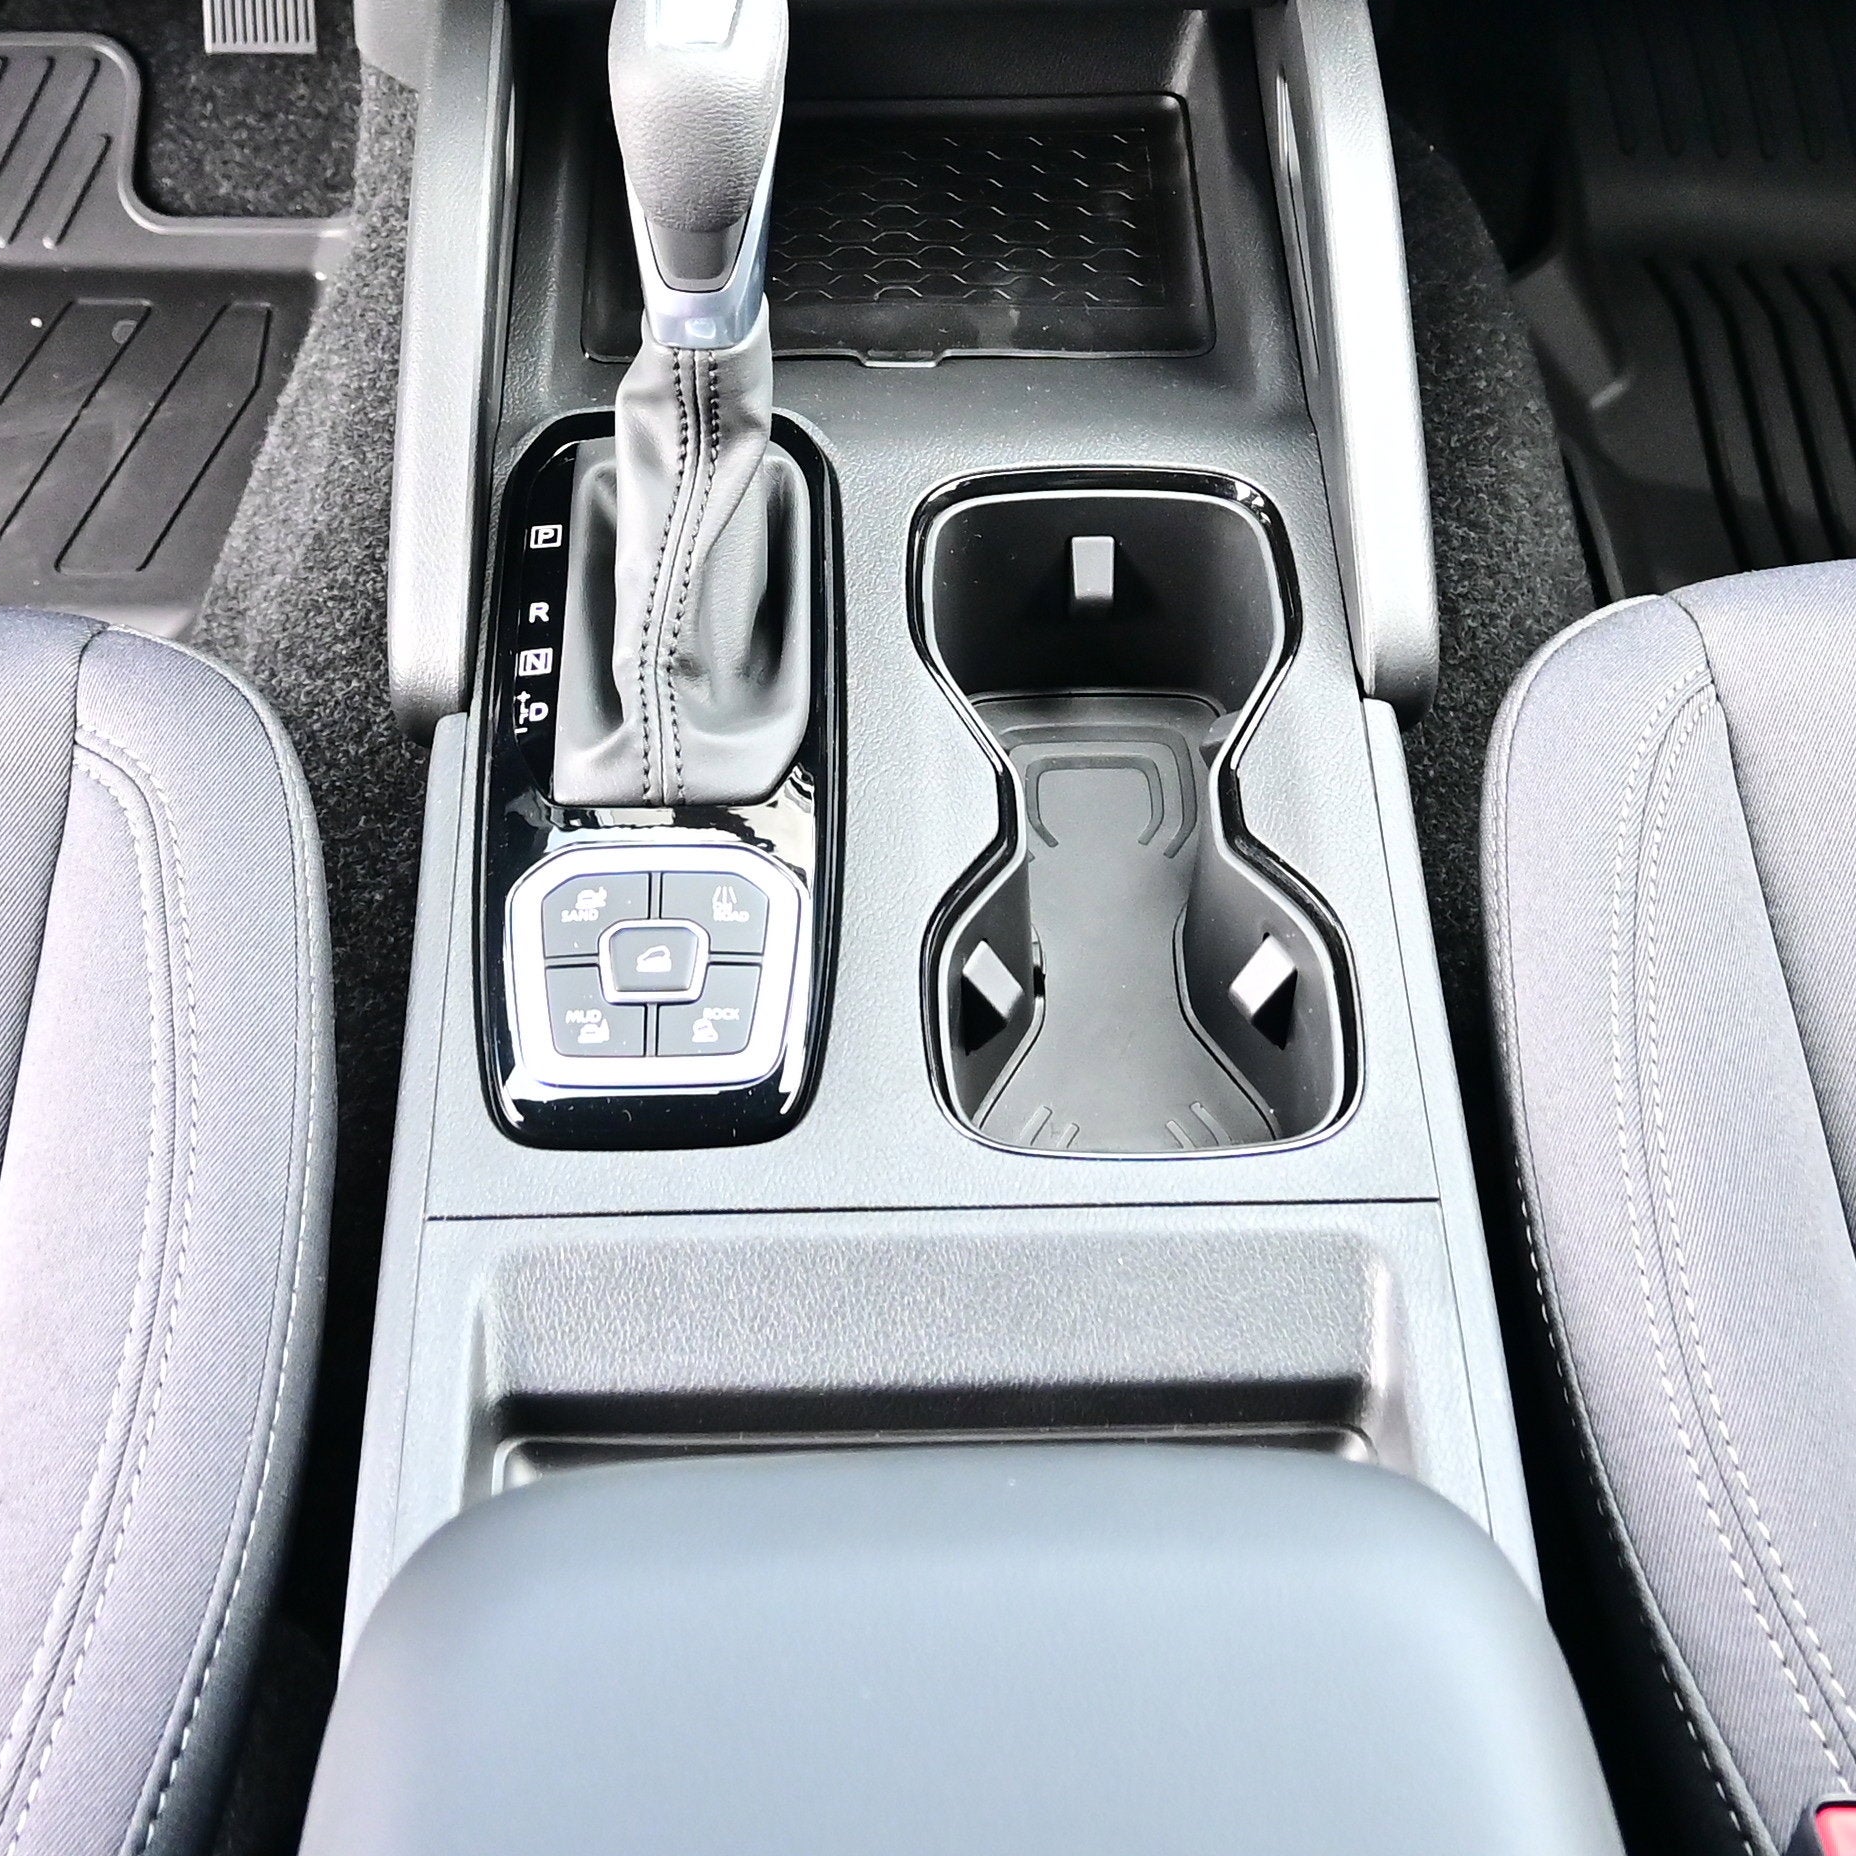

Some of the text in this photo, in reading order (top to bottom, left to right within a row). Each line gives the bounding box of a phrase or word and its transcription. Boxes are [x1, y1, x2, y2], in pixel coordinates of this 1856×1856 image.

[536, 528, 555, 546] P
[528, 601, 550, 624] R
[526, 652, 545, 672] N
[528, 701, 549, 722] D
[560, 909, 599, 923] SAND
[565, 1008, 602, 1024] MUD
